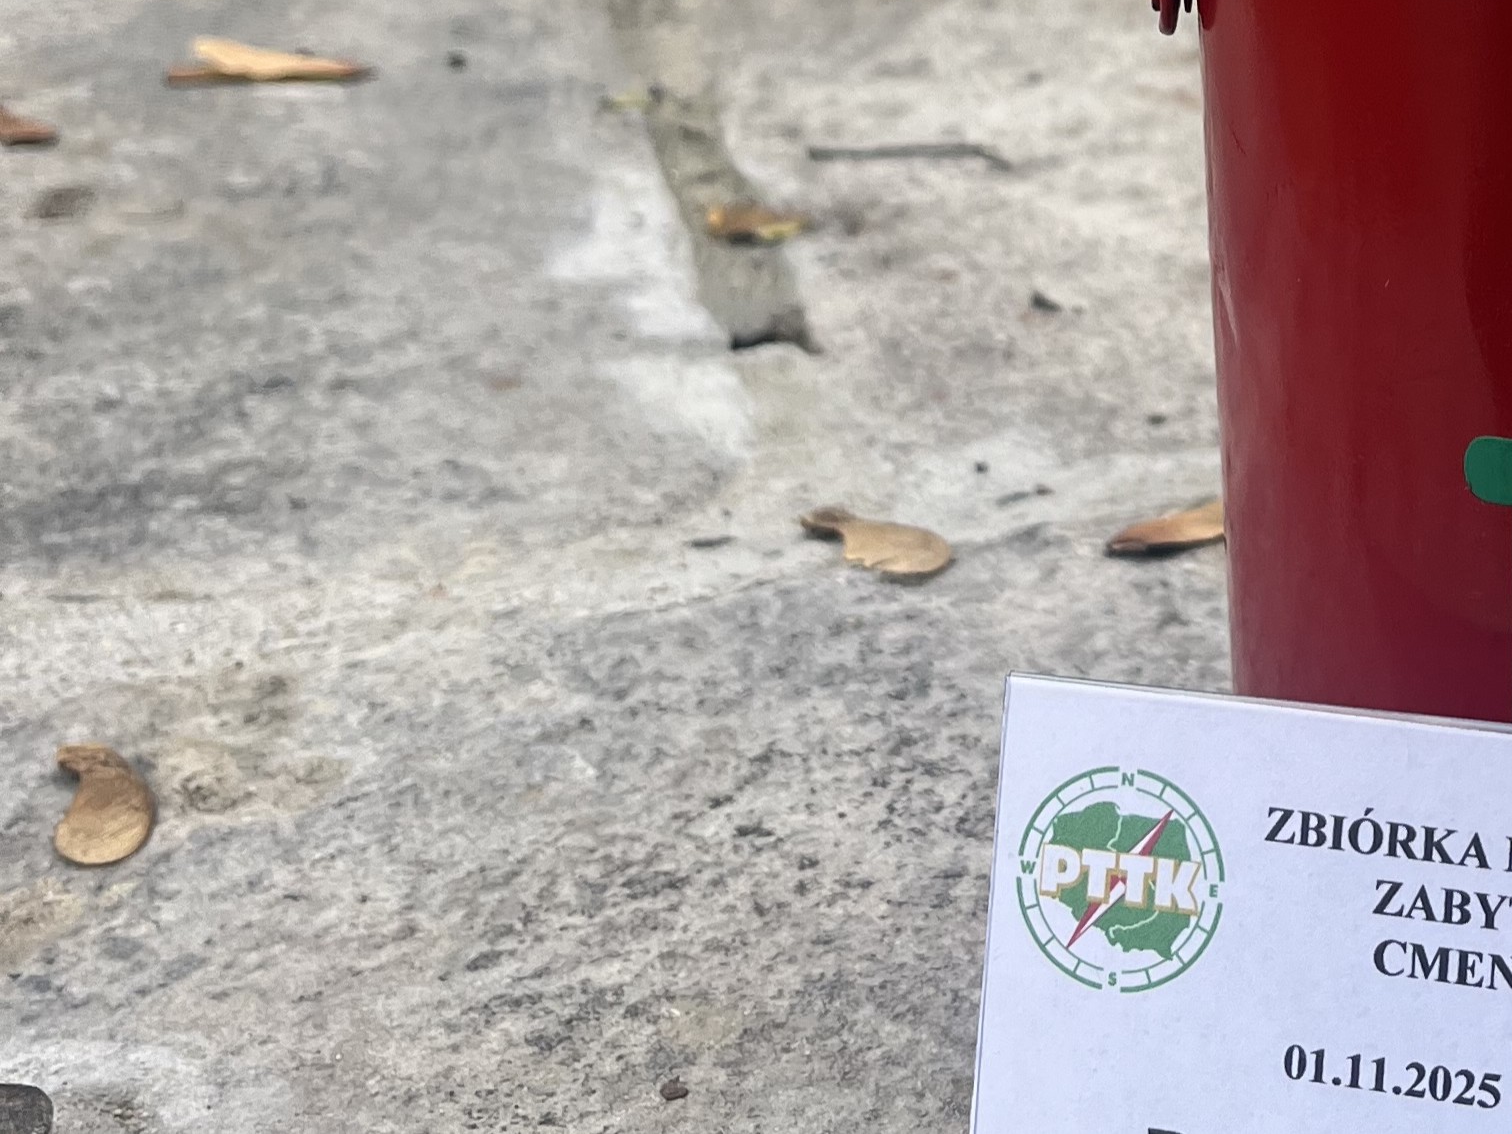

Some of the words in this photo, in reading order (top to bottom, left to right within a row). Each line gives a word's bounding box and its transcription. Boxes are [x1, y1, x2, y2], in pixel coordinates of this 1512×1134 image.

[1121, 772, 1135, 787] N
[1264, 807, 1492, 870] ZBIÓRKA
[1039, 842, 1201, 916] PTTK
[1283, 1044, 1502, 1109] 01.11.2025
